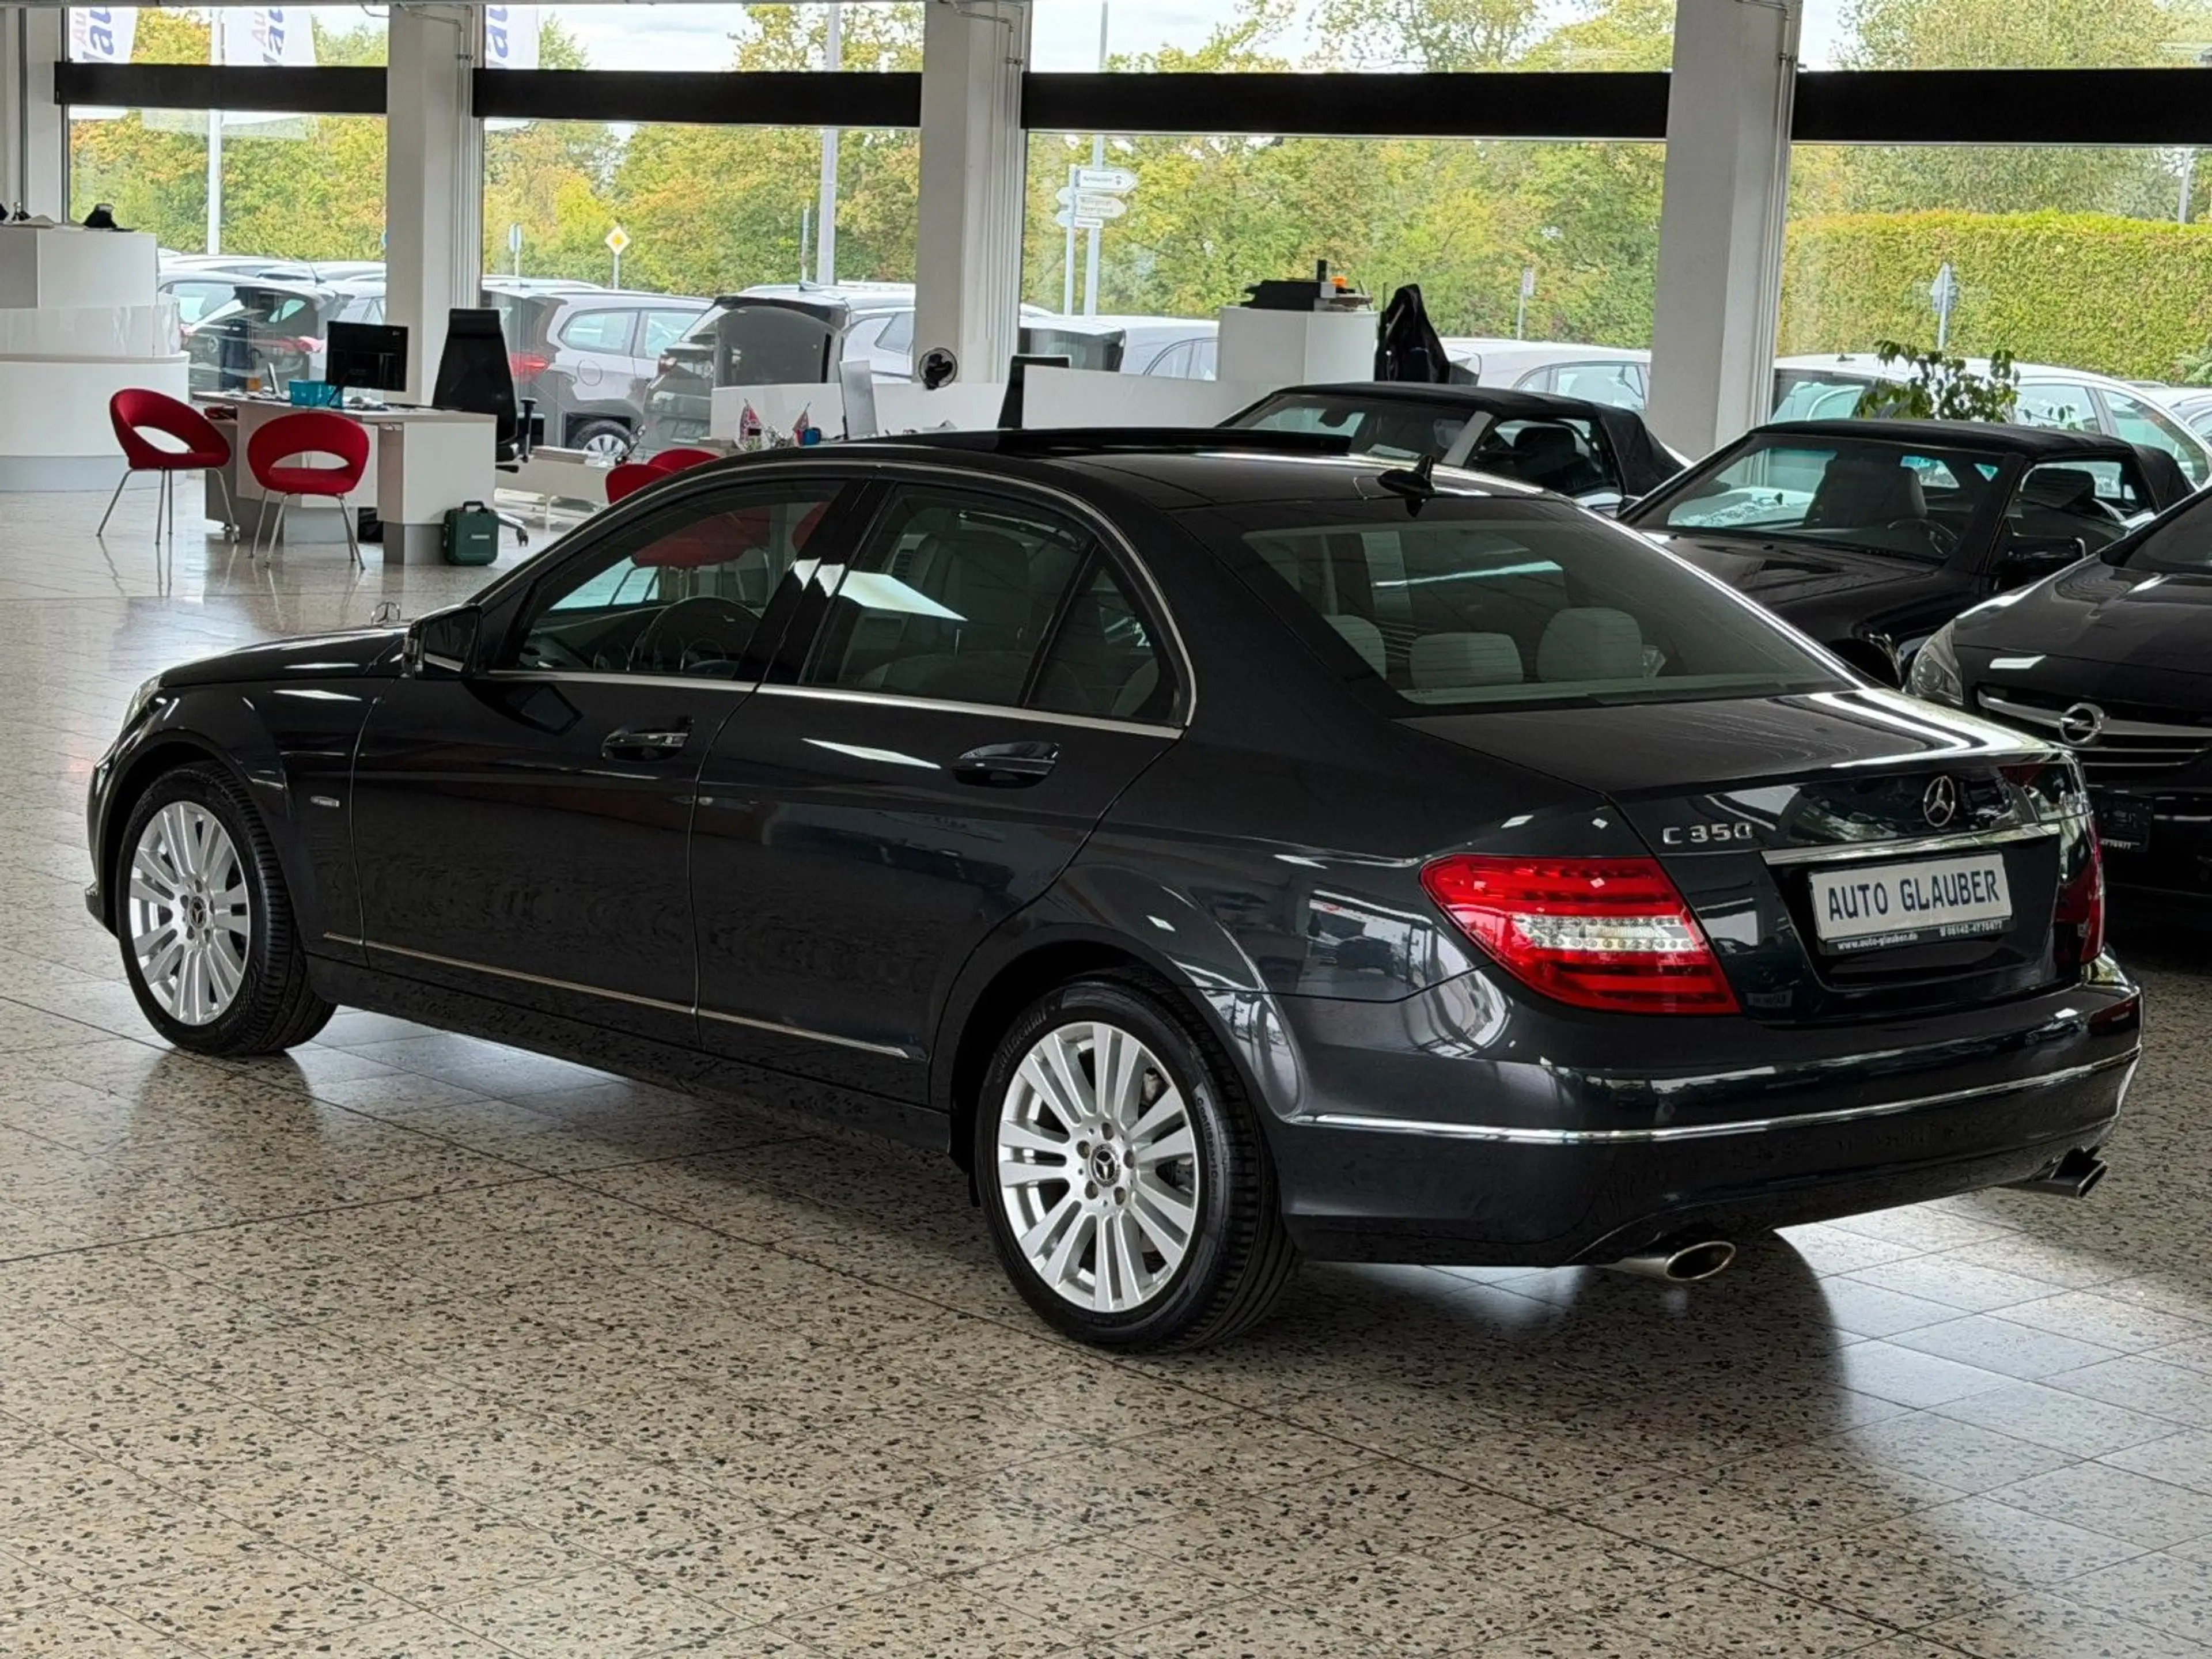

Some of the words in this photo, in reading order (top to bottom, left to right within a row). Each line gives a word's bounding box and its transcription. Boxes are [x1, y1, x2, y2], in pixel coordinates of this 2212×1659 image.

[1663, 827, 1683, 844] C
[1690, 822, 1752, 843] 350
[1828, 882, 1888, 922] AUTO
[1900, 869, 2000, 912] GLAUBER
